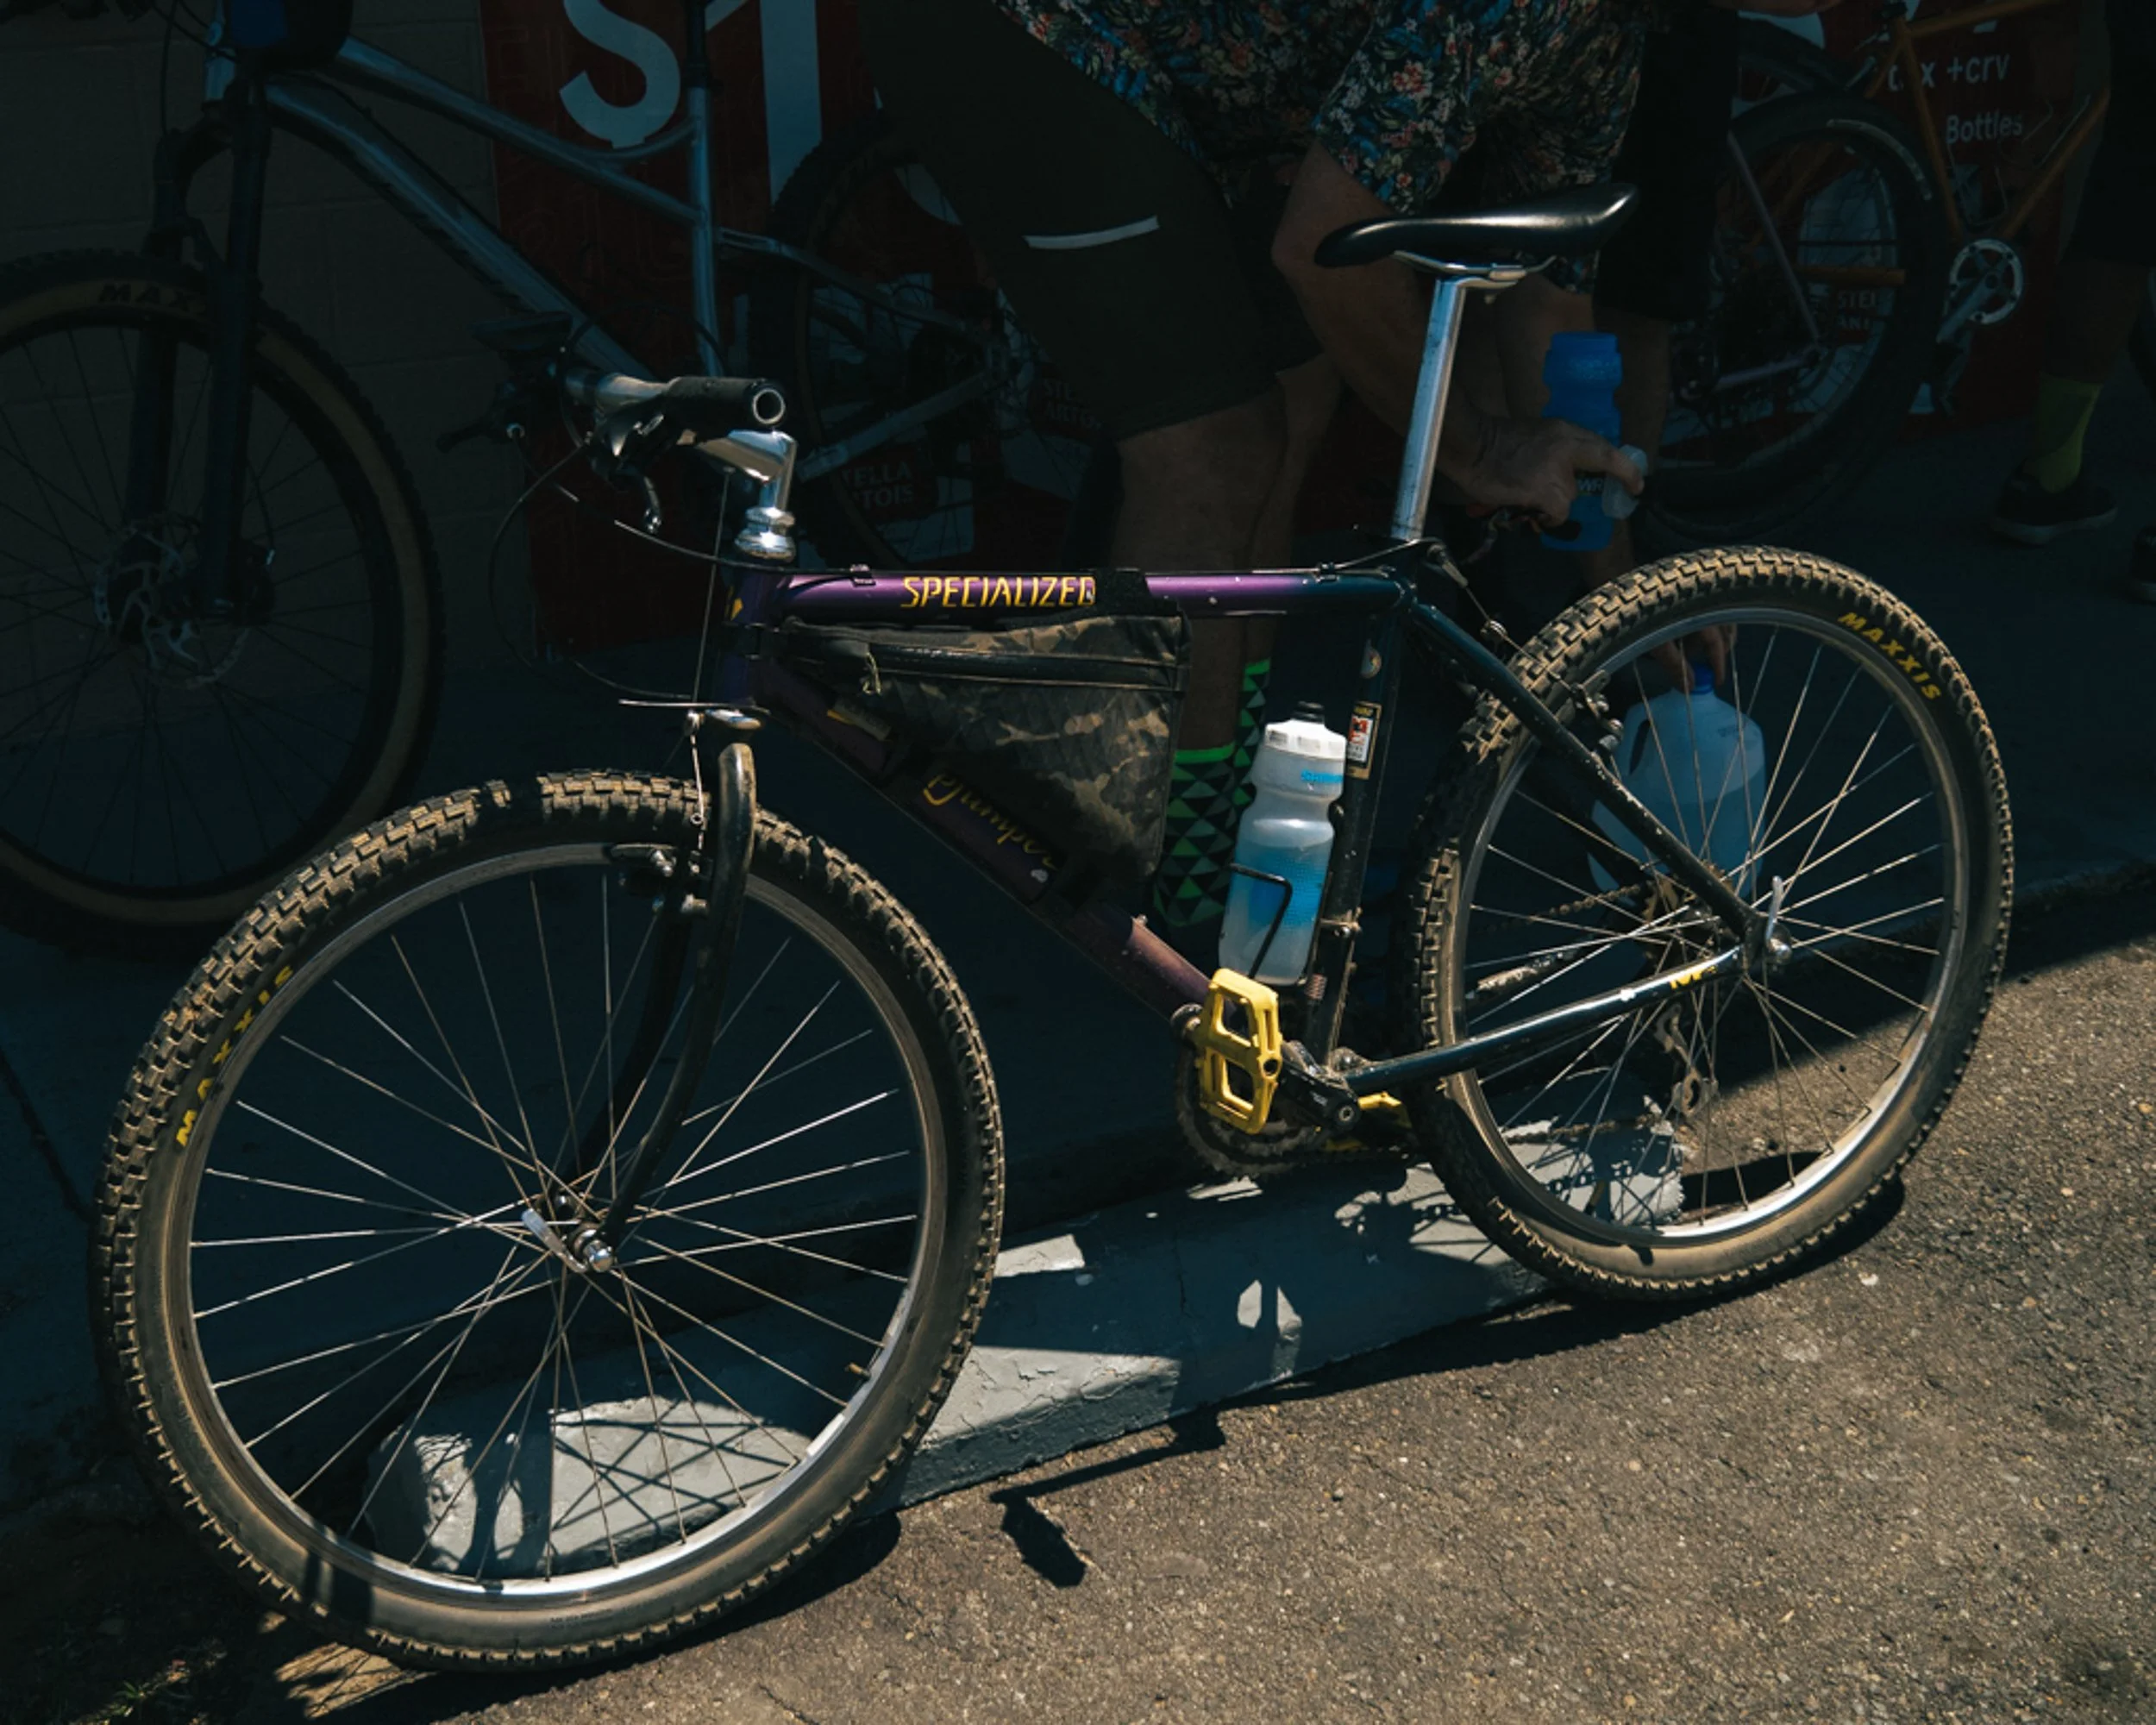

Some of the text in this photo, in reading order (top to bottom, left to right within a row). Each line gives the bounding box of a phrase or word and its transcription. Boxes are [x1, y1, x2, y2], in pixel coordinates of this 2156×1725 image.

[1946, 107, 2023, 145] Bottles
[99, 282, 204, 312] MAX
[900, 576, 1096, 608] SPECIALIZED
[1837, 612, 1941, 699] MAXXIS
[175, 965, 294, 1147] MAXXIS
